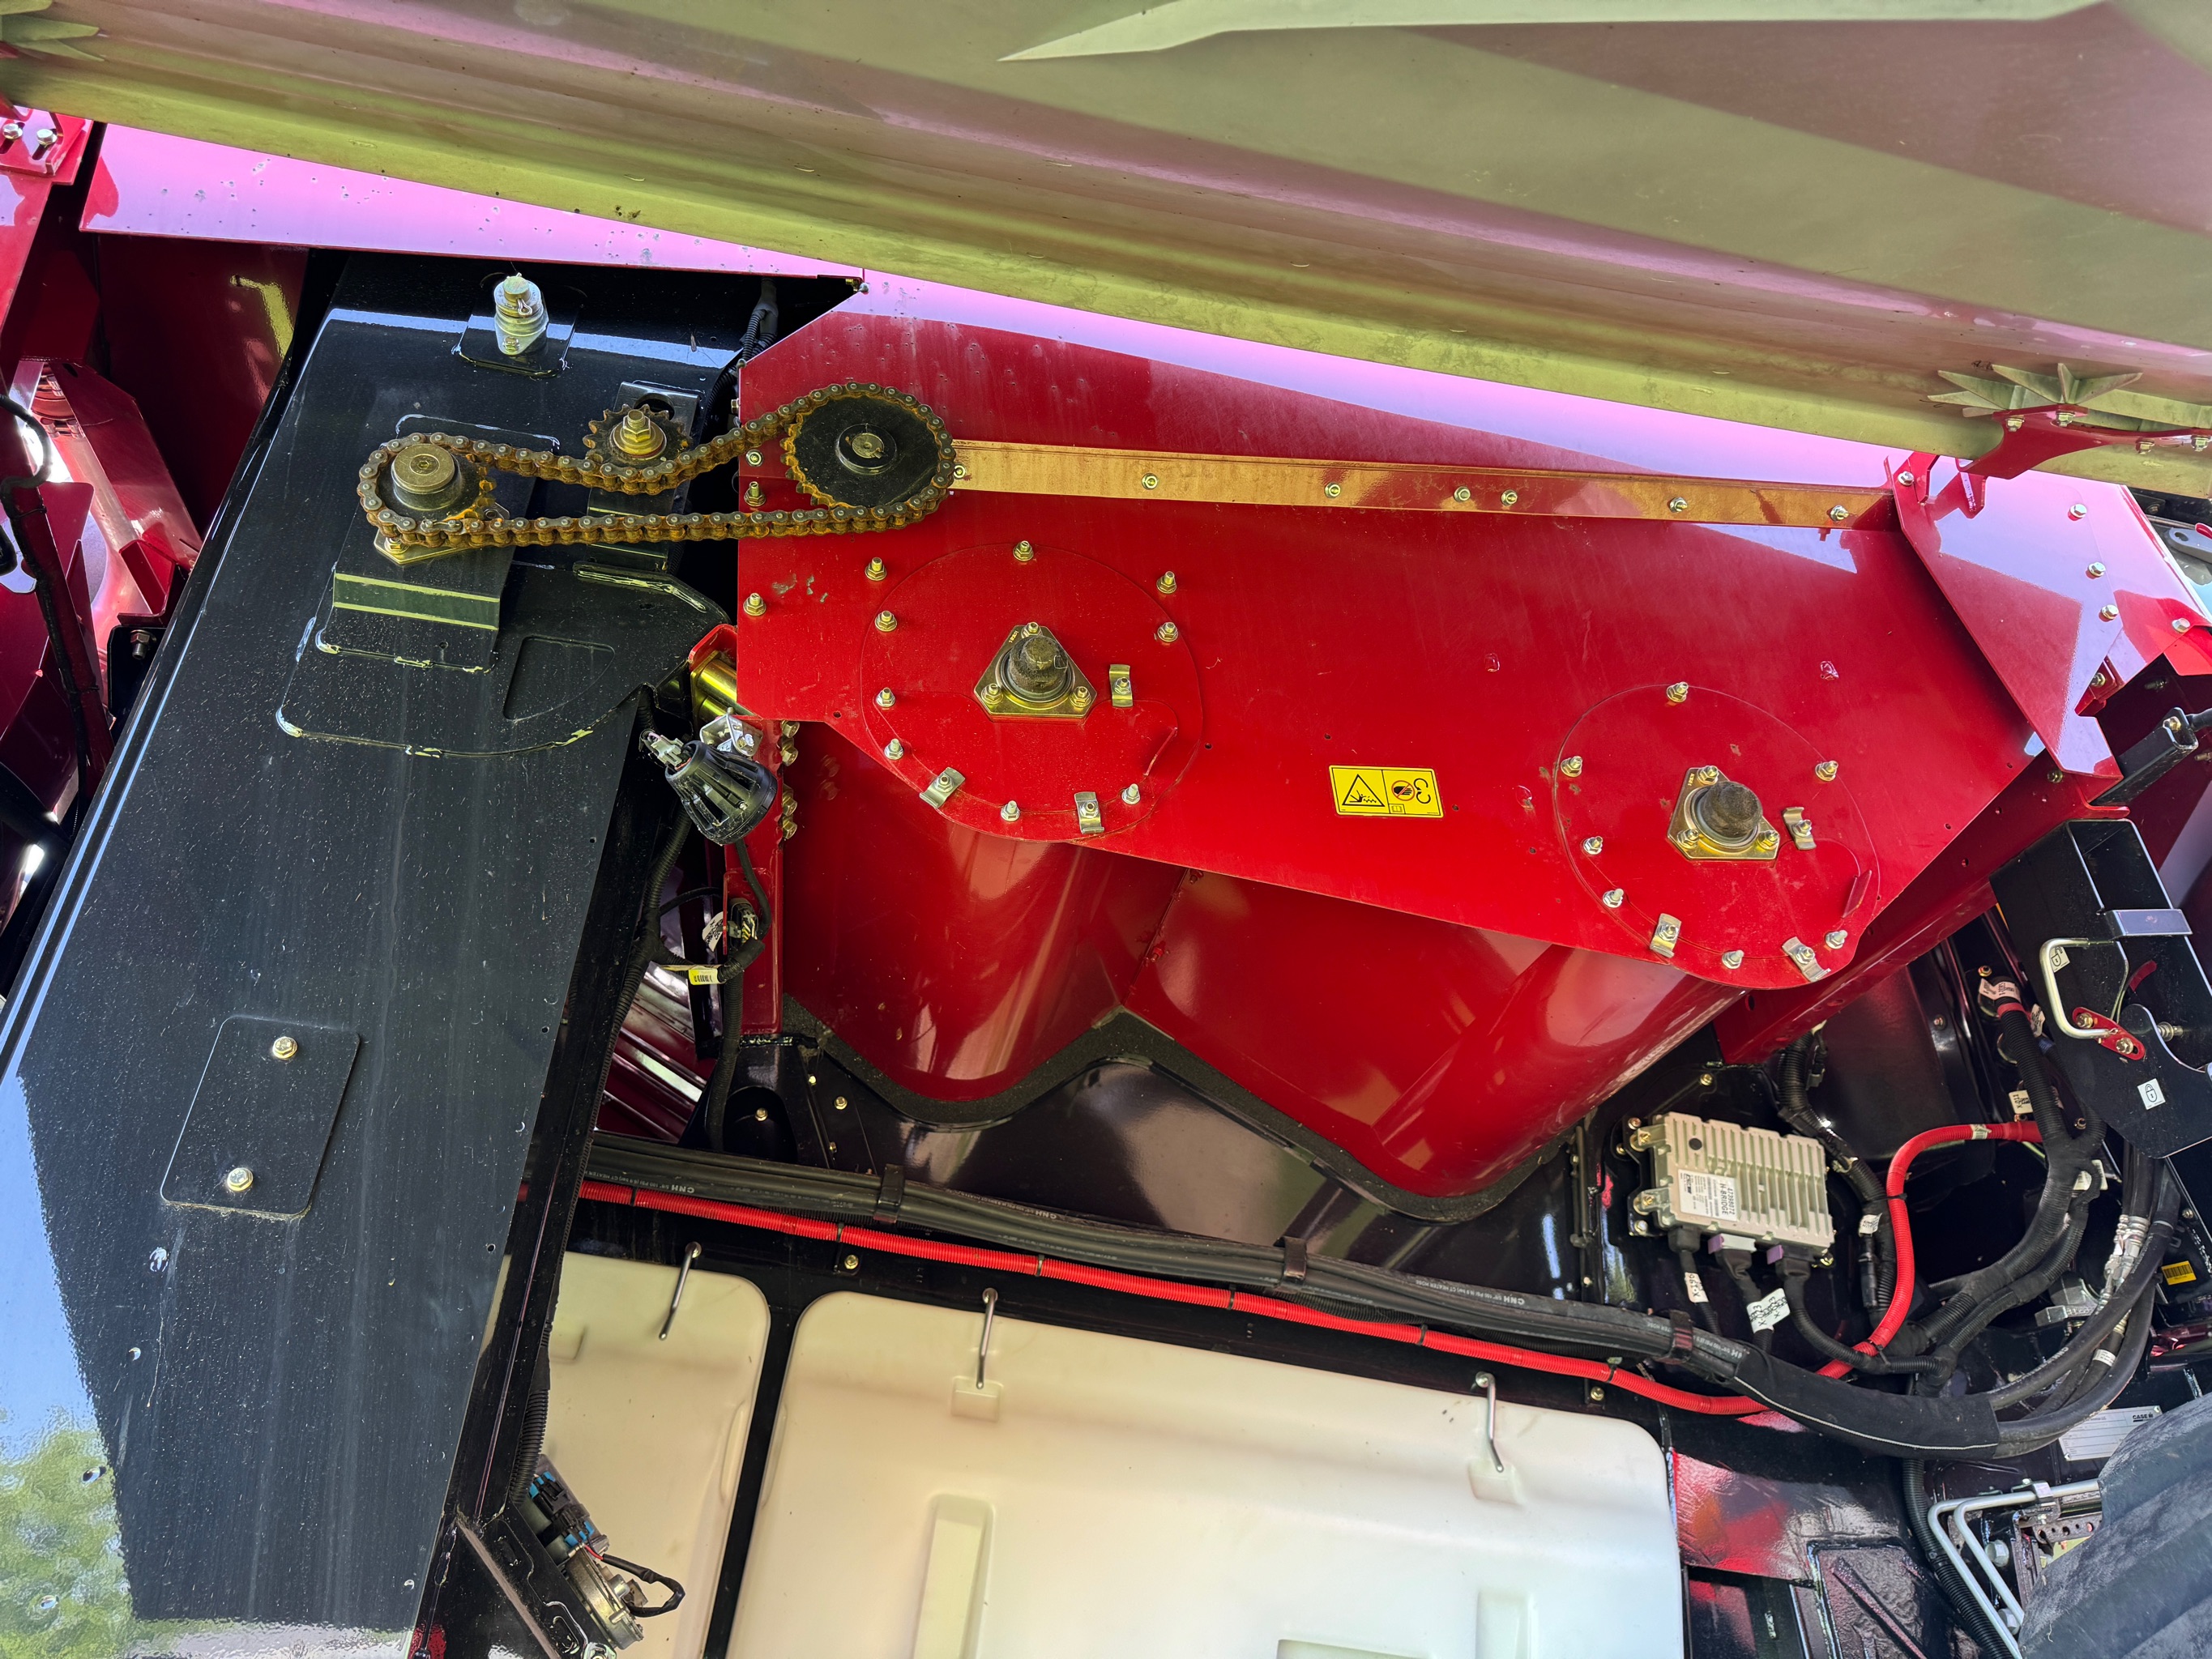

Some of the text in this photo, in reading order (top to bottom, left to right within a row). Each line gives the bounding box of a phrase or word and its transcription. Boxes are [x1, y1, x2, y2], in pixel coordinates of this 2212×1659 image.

[589, 1171, 610, 1179] HEATER
[672, 1184, 694, 1194] CNH
[1719, 1183, 1728, 1215] H-BRIDGE
[1036, 1210, 1057, 1219] CNH
[1429, 1282, 1449, 1291] HEATER
[1503, 1295, 1525, 1305] CNH
